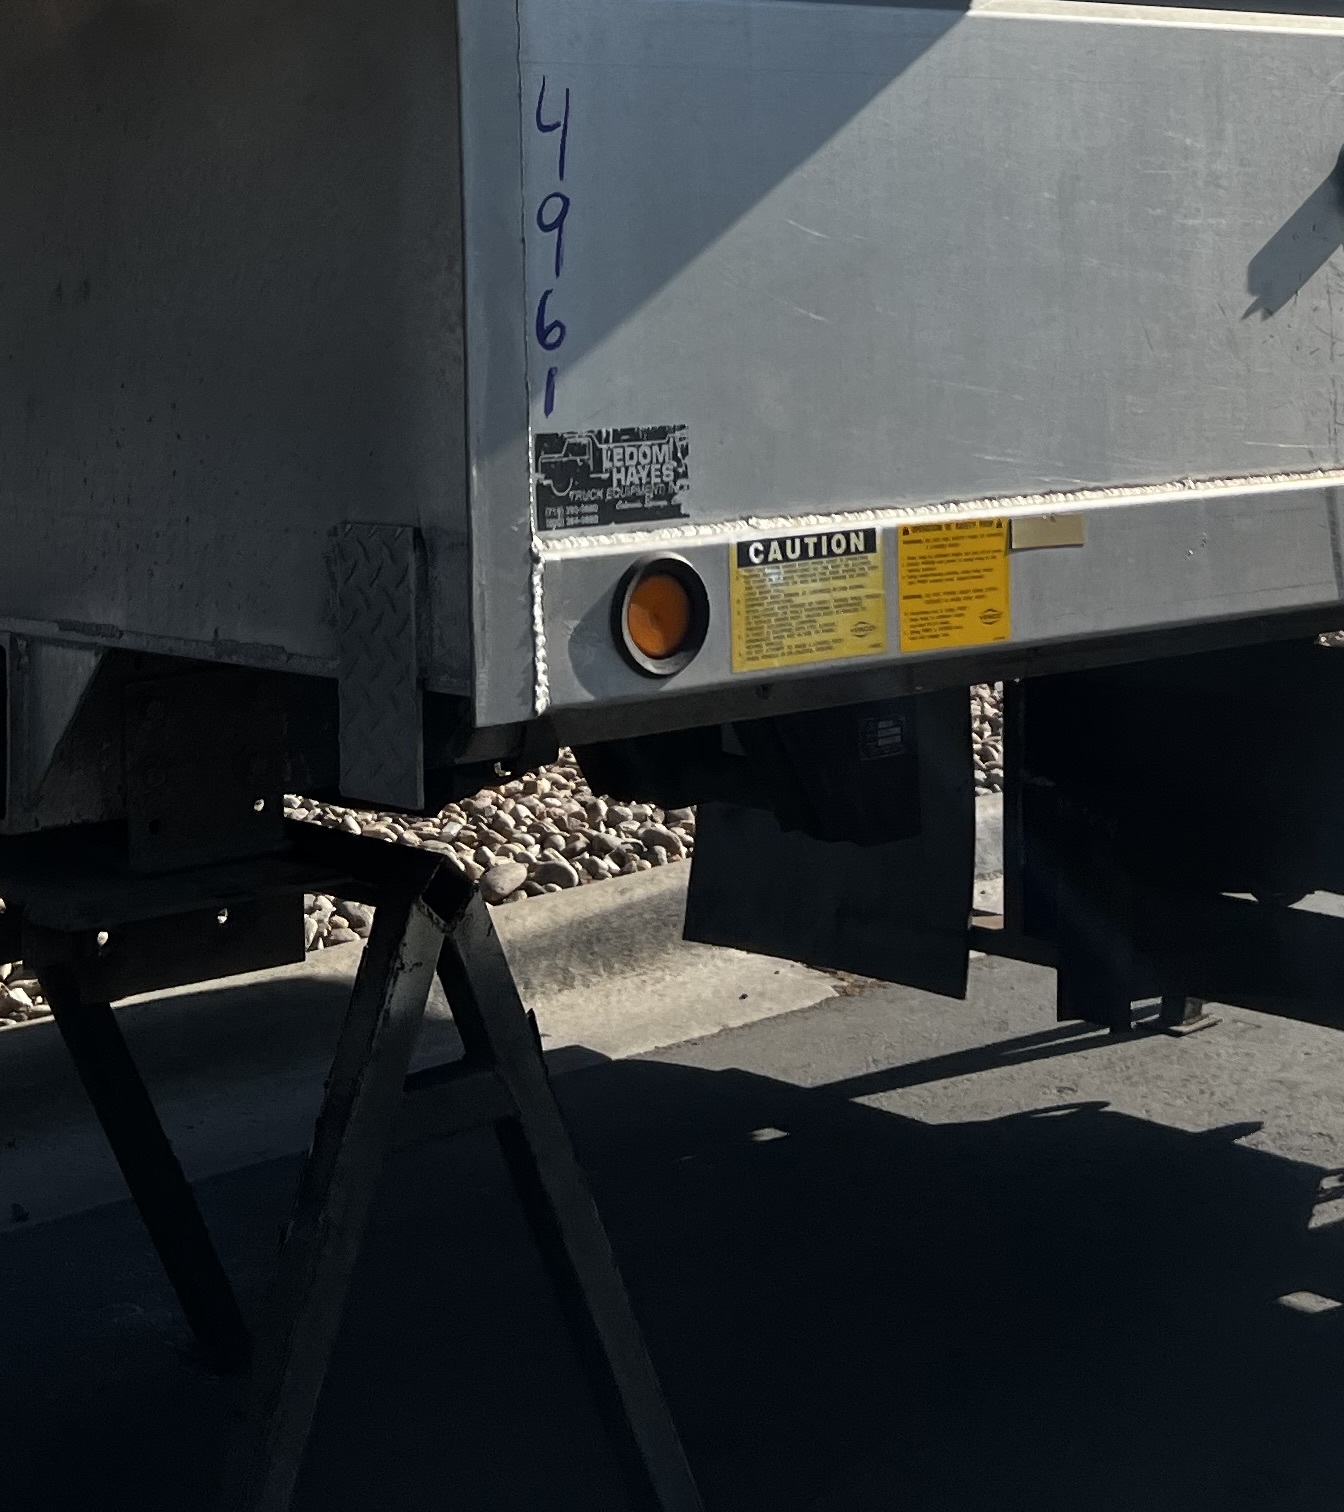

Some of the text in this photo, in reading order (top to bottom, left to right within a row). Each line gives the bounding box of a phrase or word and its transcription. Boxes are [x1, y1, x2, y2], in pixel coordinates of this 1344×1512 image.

[536, 75, 570, 418] 4961
[613, 462, 675, 488] HAYES
[748, 531, 866, 565] CAUTION
